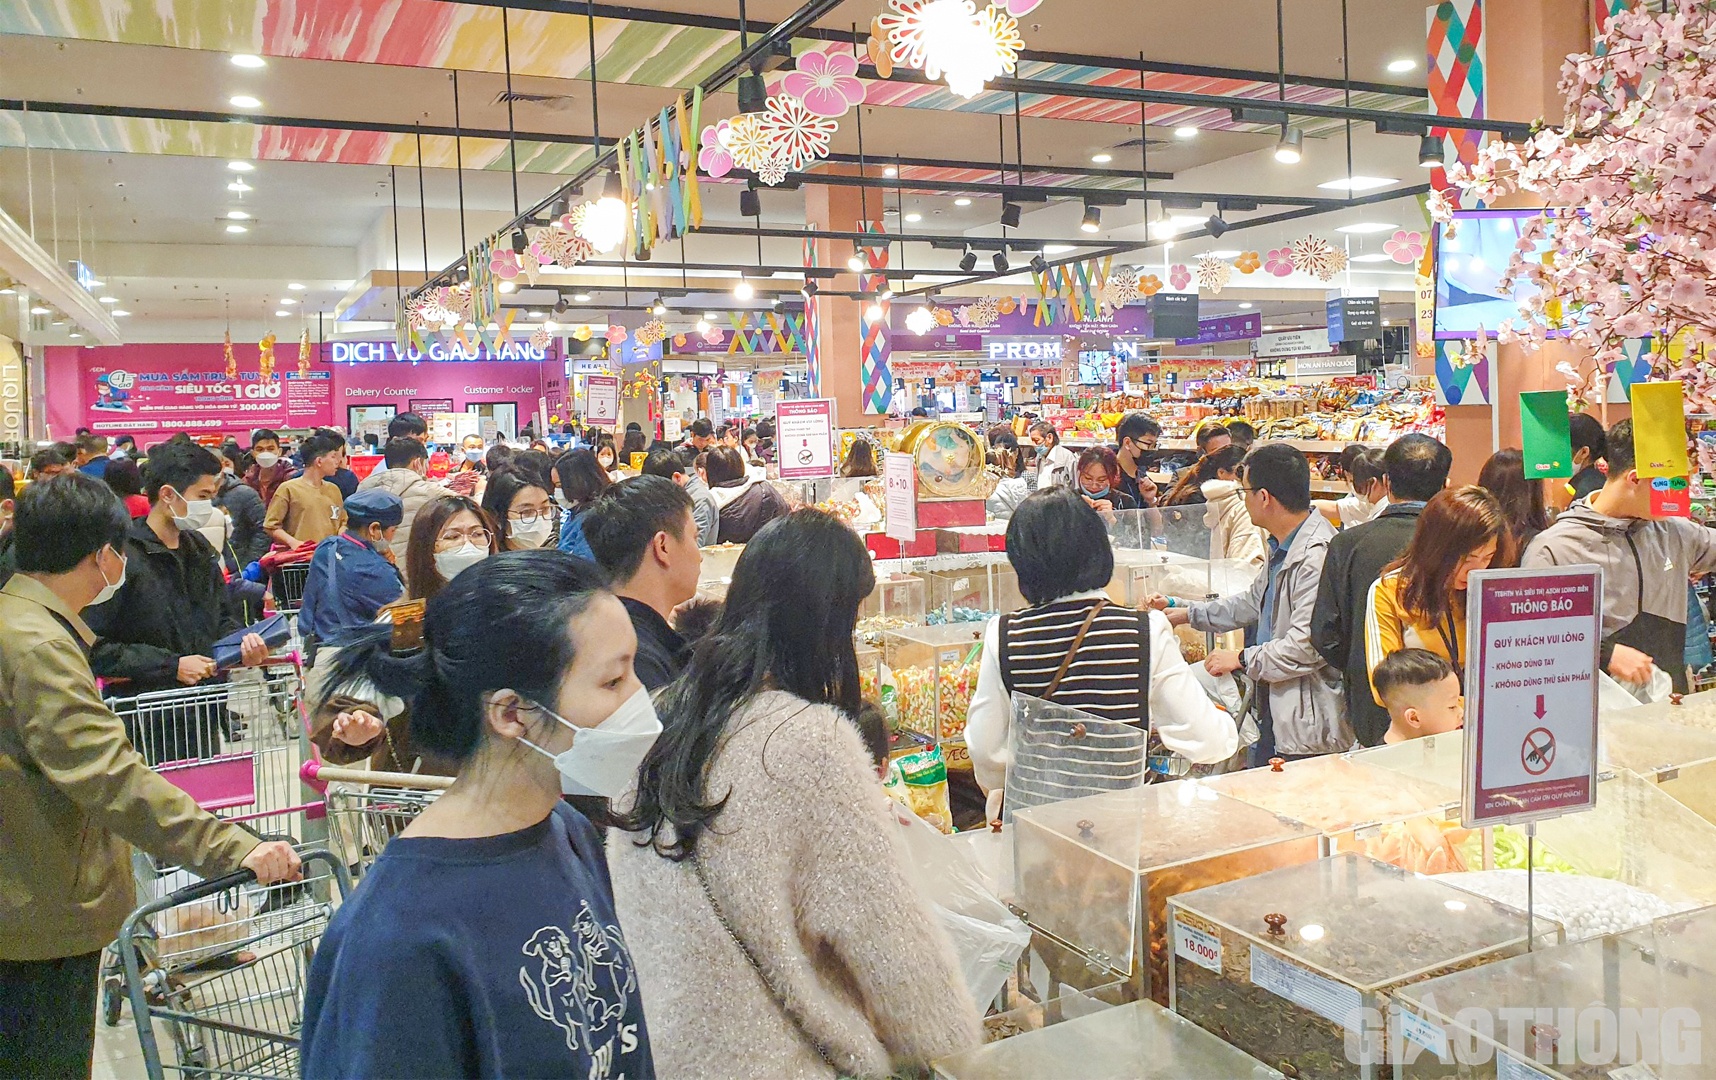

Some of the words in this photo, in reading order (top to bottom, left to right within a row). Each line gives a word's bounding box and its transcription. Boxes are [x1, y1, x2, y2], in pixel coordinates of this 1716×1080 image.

[1421, 290, 1432, 299] 07
[1421, 310, 1433, 319] 23
[139, 373, 169, 381] MUA
[175, 383, 203, 394] SIÊU
[205, 381, 232, 394] TỐC
[233, 384, 242, 399] 1
[244, 381, 281, 399] GIỜ
[345, 387, 381, 398] Delivery
[383, 387, 418, 396] Counter
[463, 385, 504, 394] Customer
[889, 477, 894, 488] 8
[1524, 587, 1536, 597] SIÊU
[1561, 586, 1577, 594] LONG
[1510, 599, 1548, 614] THÔNG
[1550, 596, 1573, 612] BÁO
[1494, 636, 1513, 649] QUÝ
[1514, 634, 1545, 647] KHÁCH
[1546, 634, 1560, 644] VUI
[1561, 631, 1585, 643] LÒNG
[1496, 660, 1523, 671] KHÔNG
[1523, 658, 1543, 669] DÙNG
[1544, 657, 1555, 666] TAY
[1495, 678, 1522, 689] KHÔNG
[1523, 676, 1542, 687] DÙNG
[1571, 669, 1591, 681] PHẨM
